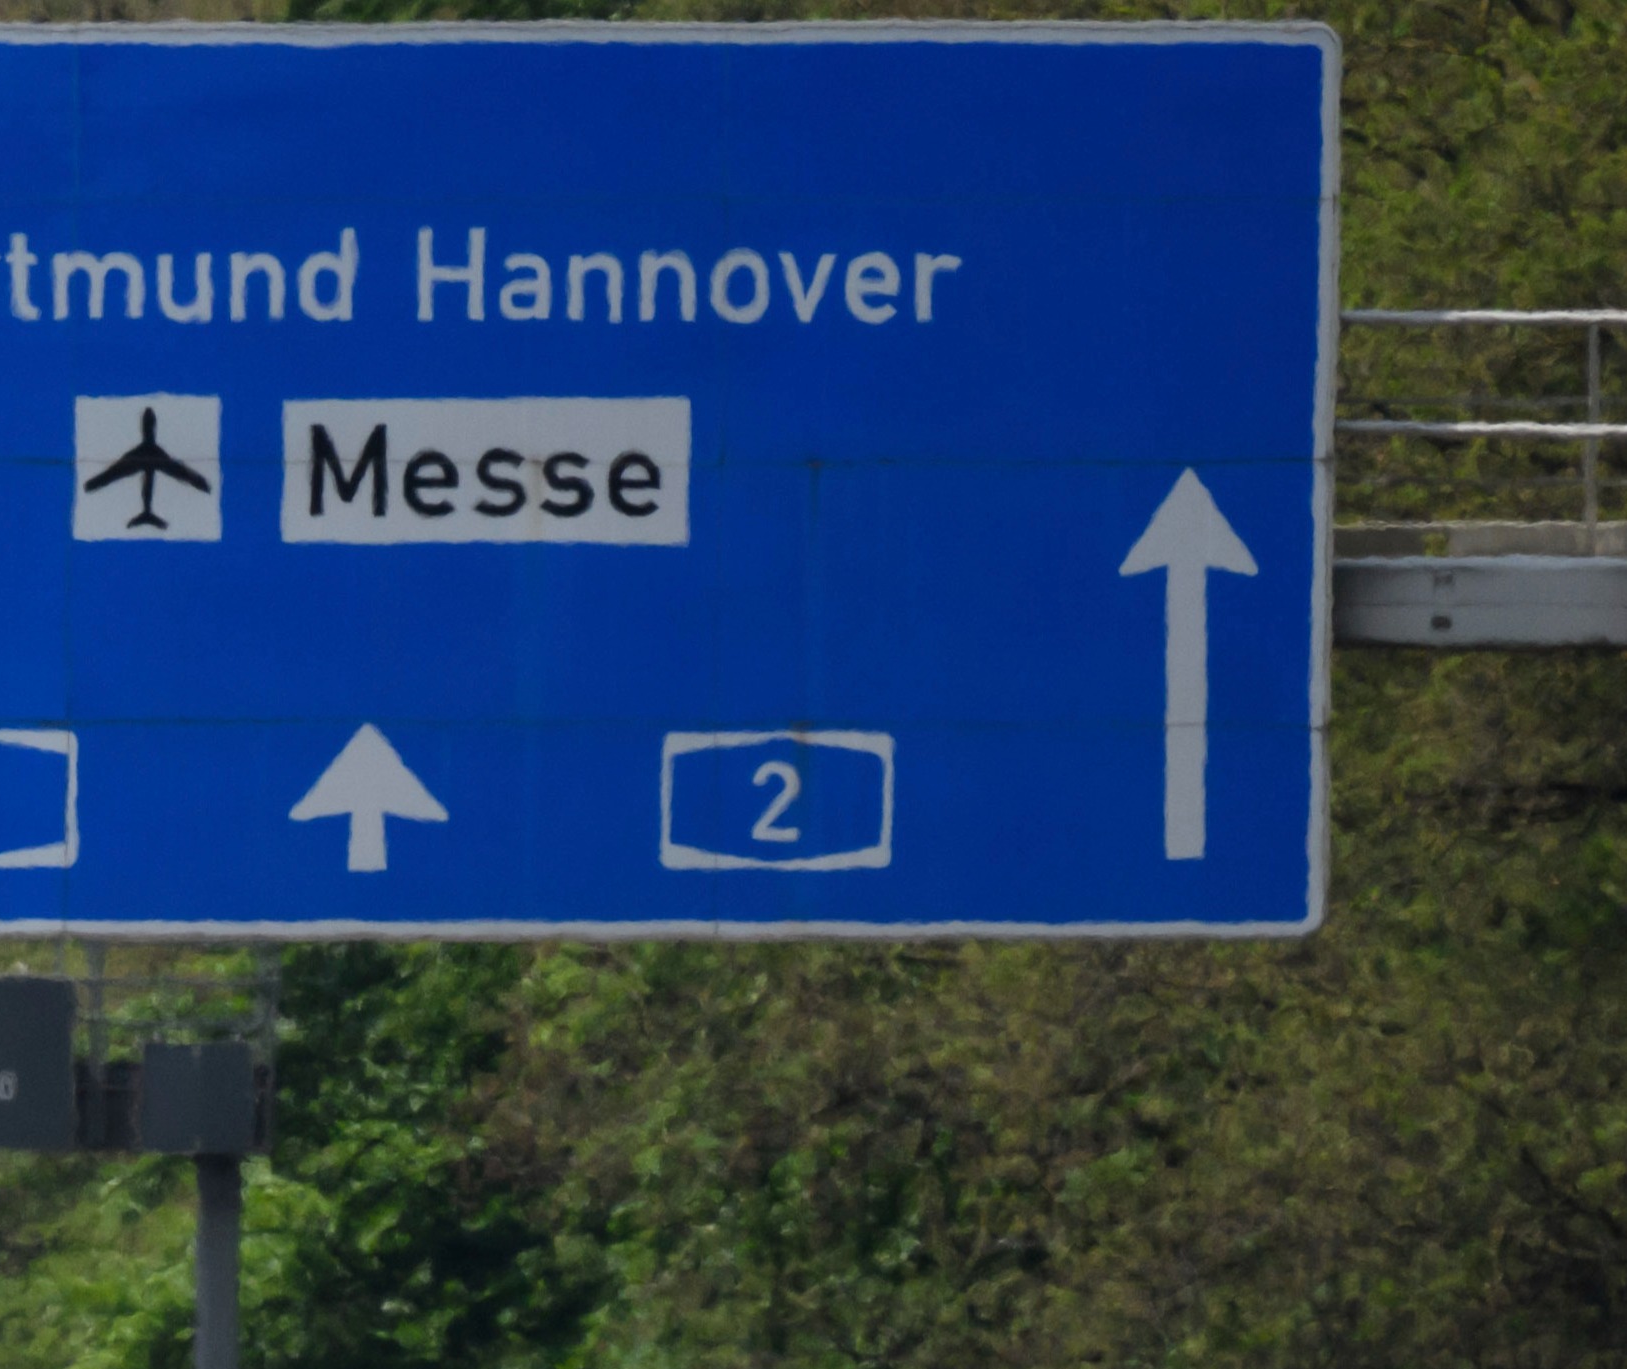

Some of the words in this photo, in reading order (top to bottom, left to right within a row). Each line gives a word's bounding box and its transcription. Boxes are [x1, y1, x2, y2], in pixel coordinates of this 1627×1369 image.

[416, 227, 963, 325] Hannover
[306, 423, 663, 520] Messe
[750, 760, 802, 842] 2
